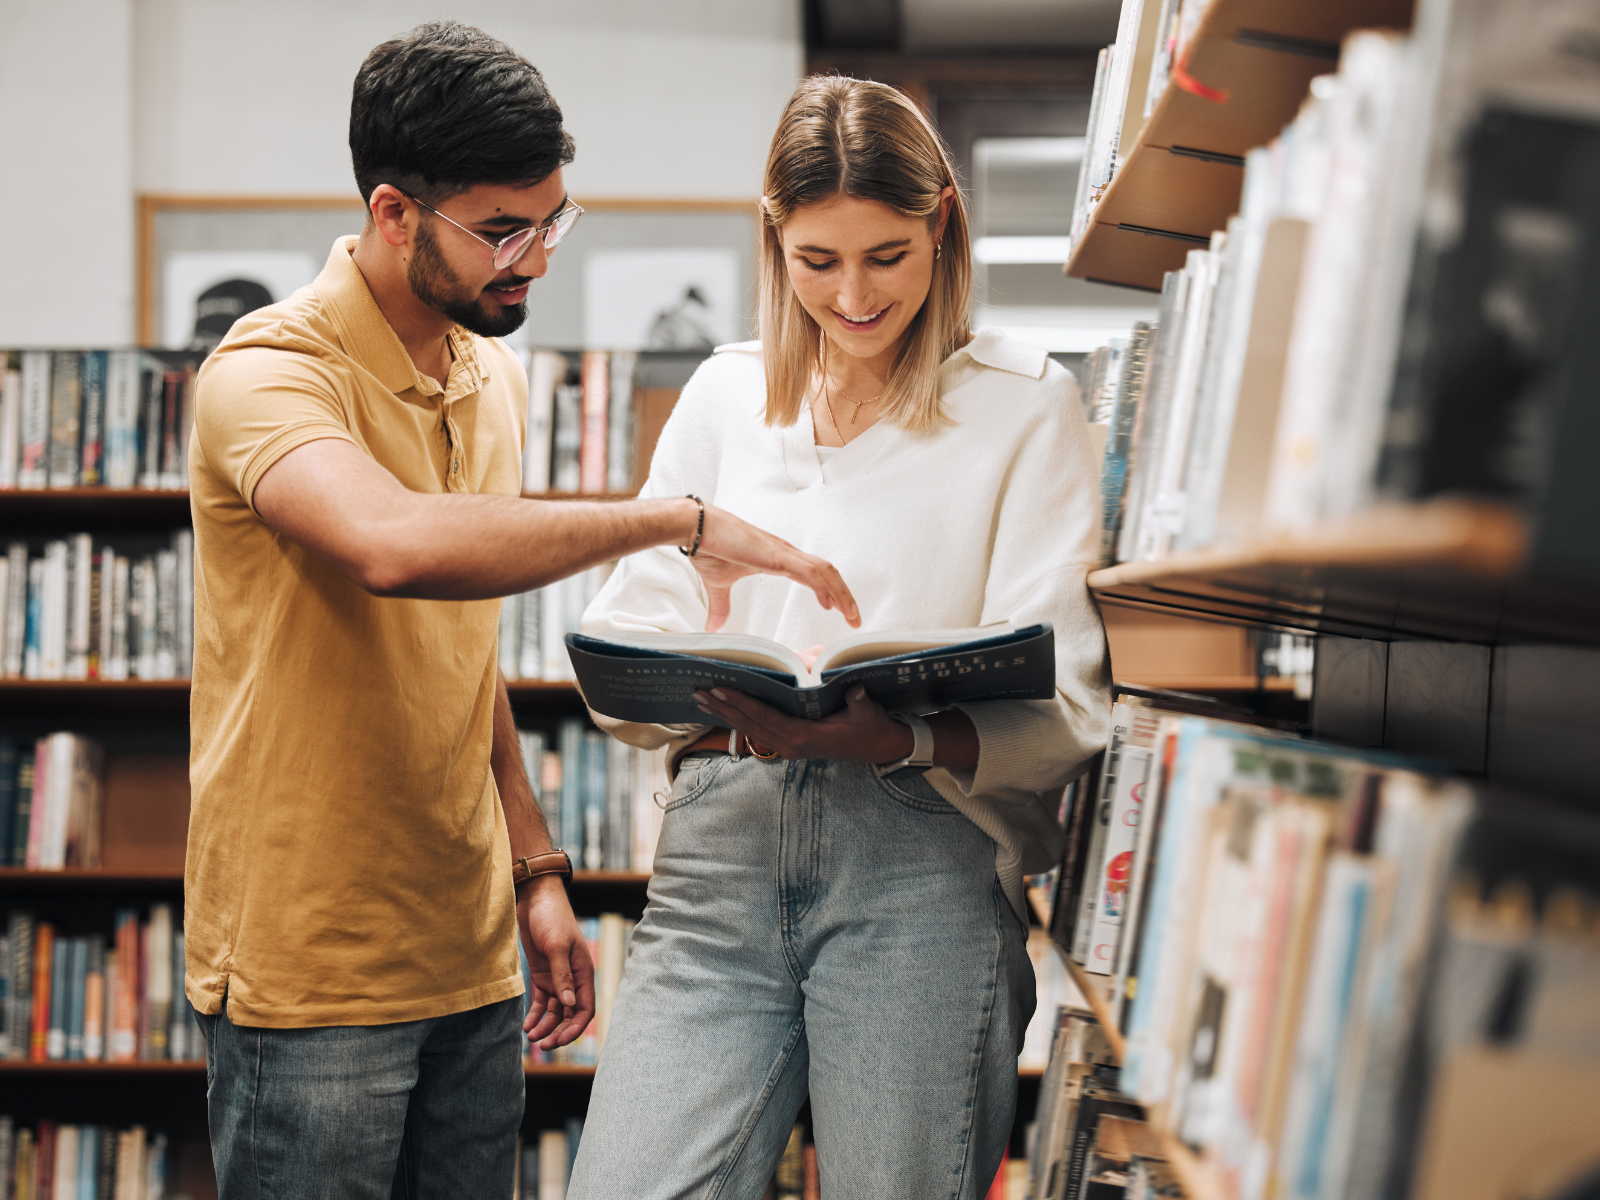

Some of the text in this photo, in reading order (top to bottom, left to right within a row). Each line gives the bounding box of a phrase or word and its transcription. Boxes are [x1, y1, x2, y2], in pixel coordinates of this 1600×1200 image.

[676, 669, 737, 681] STUDIES
[897, 656, 984, 675] BIBLE
[897, 657, 1026, 684] STUDIES
